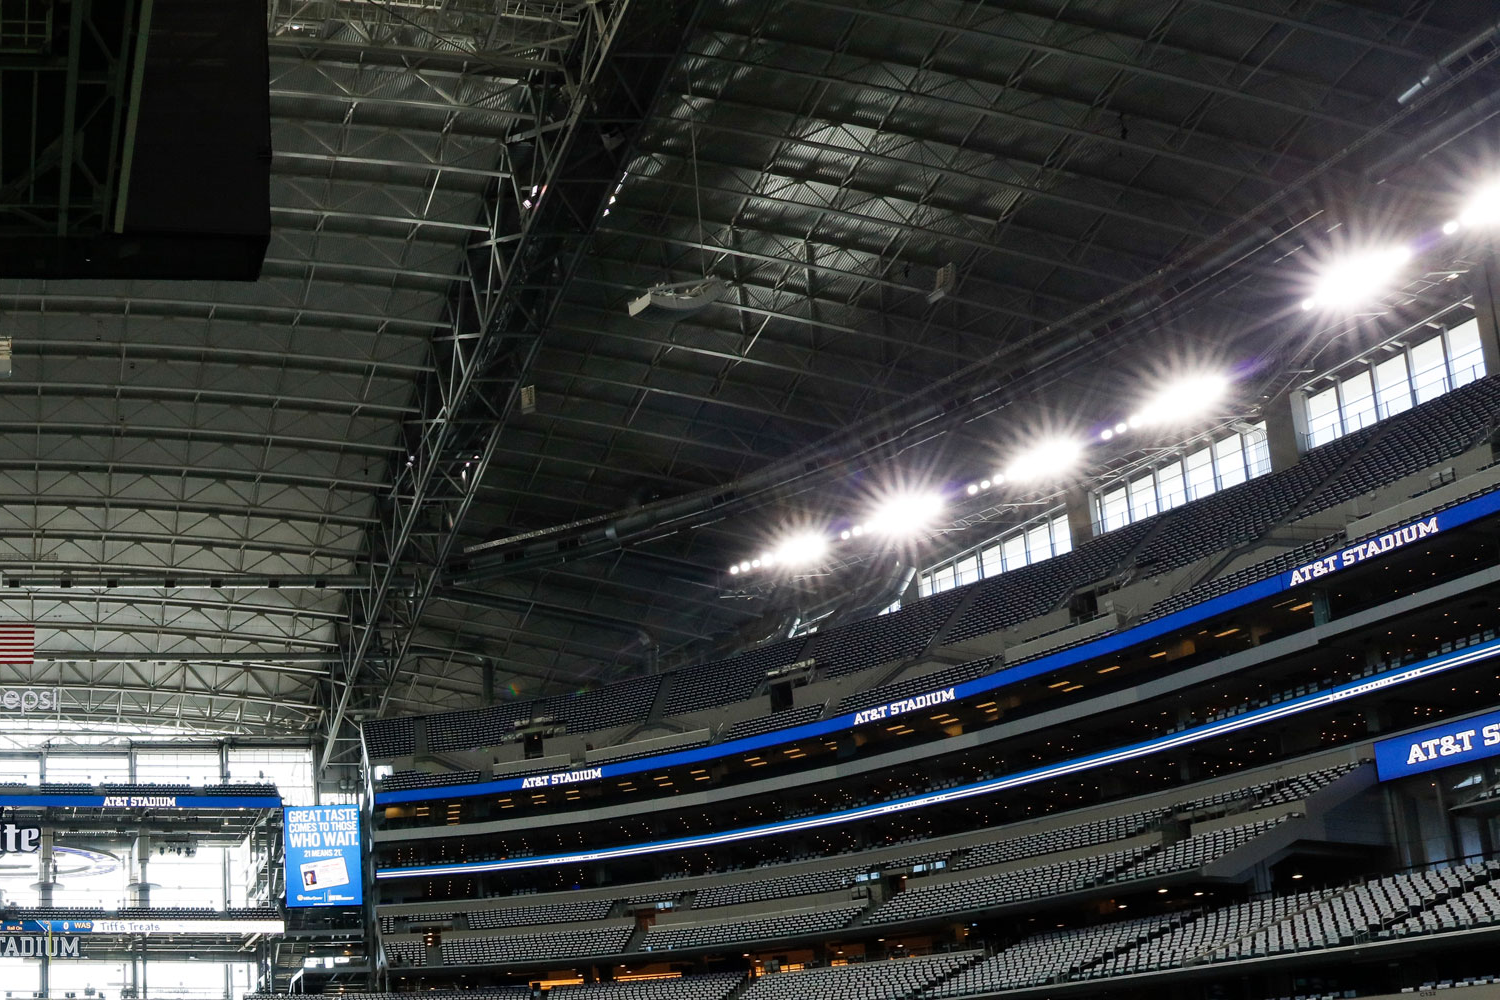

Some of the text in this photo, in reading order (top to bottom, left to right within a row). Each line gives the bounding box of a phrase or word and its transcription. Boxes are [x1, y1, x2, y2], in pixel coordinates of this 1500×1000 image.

[1290, 517, 1439, 586] AT&T STADIUM
[854, 688, 955, 725] AT&T STADIUM
[1406, 729, 1476, 765] AT&T
[522, 767, 602, 788] AT&T STADIUM
[103, 796, 176, 807] AT&T STADIUM
[288, 808, 358, 823] GREAT TASTE
[288, 820, 357, 833] COMES TO THOSE
[289, 831, 359, 848] WHO WAIT.
[311, 849, 333, 857] MEANS
[63, 921, 69, 930] 0
[100, 921, 160, 931] Tiff's Treats
